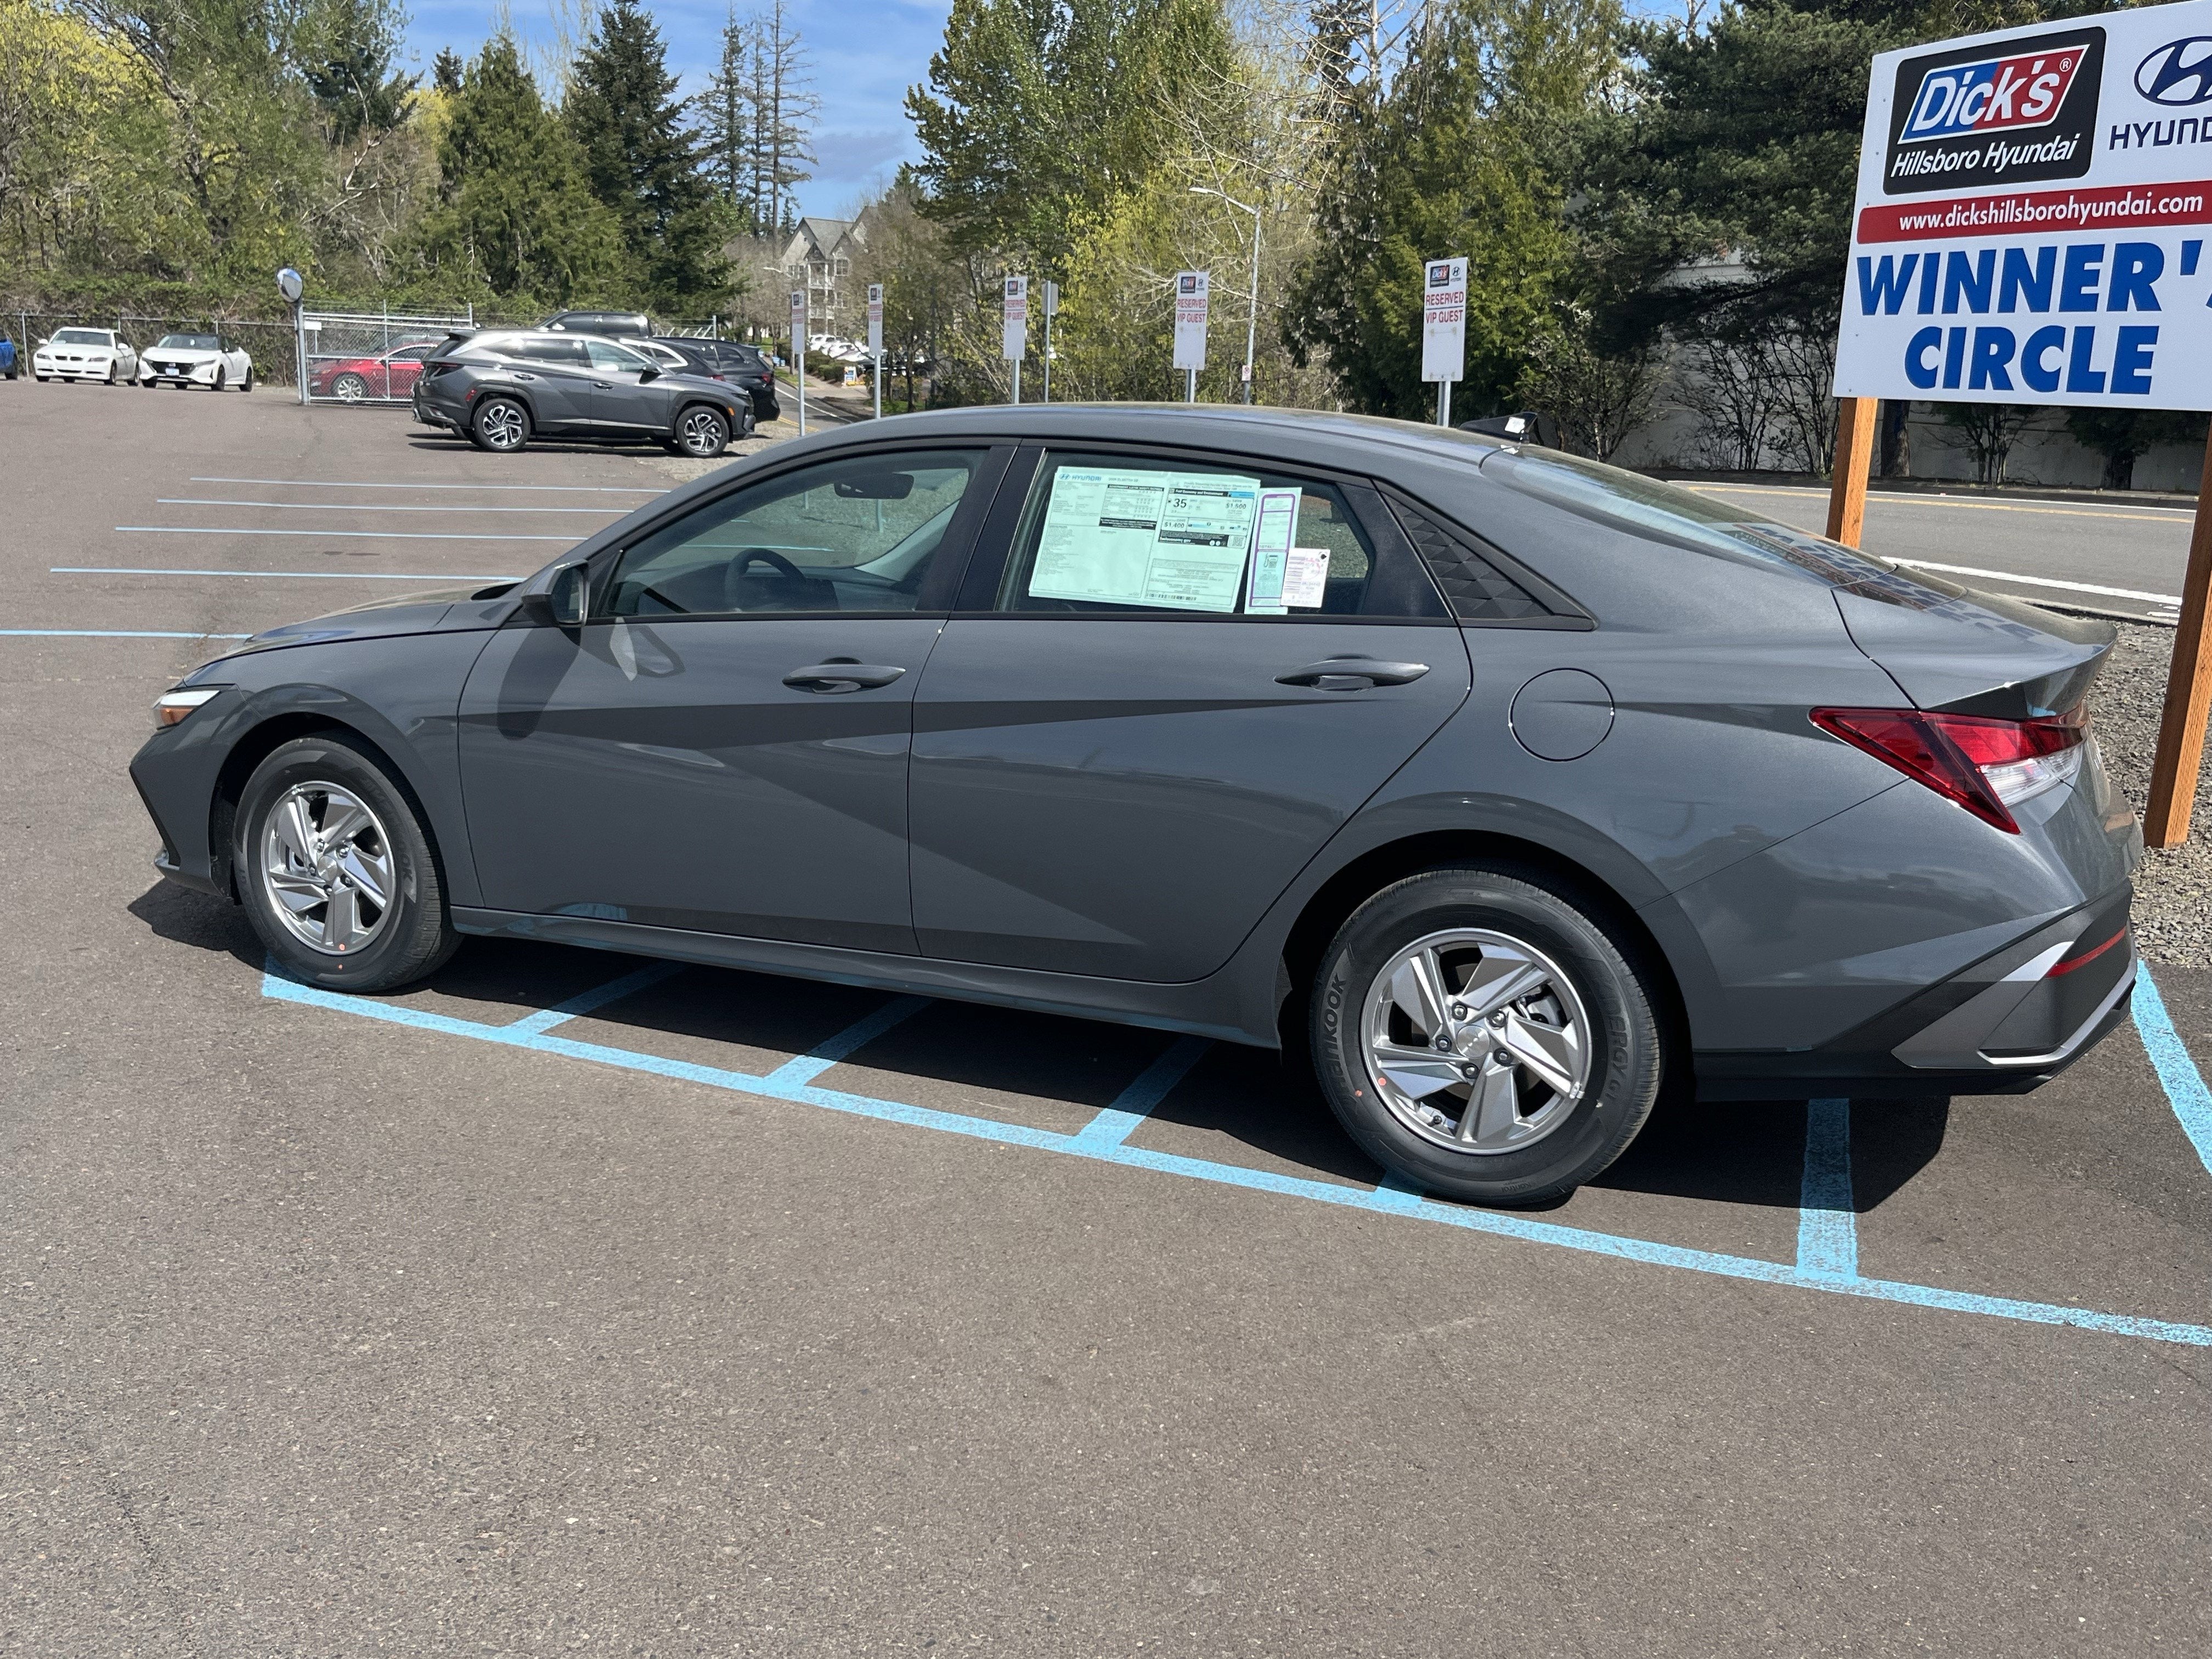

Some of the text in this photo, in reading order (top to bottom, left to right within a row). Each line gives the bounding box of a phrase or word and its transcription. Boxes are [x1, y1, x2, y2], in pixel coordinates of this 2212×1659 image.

[1912, 59, 2060, 132] Dick's
[1891, 133, 2081, 178] Hillsboro Hyundai
[1899, 191, 2203, 230] www.dickshillsborohyundai.com
[1857, 240, 2212, 317] WINNER'
[1177, 298, 1206, 308] RESERVED
[1426, 291, 1464, 306] RESERVED
[1177, 313, 1206, 323] VIP GUEST
[1426, 309, 1463, 324] VIP GUEST
[1905, 325, 2159, 395] CIRCLE
[1173, 498, 1188, 509] 35
